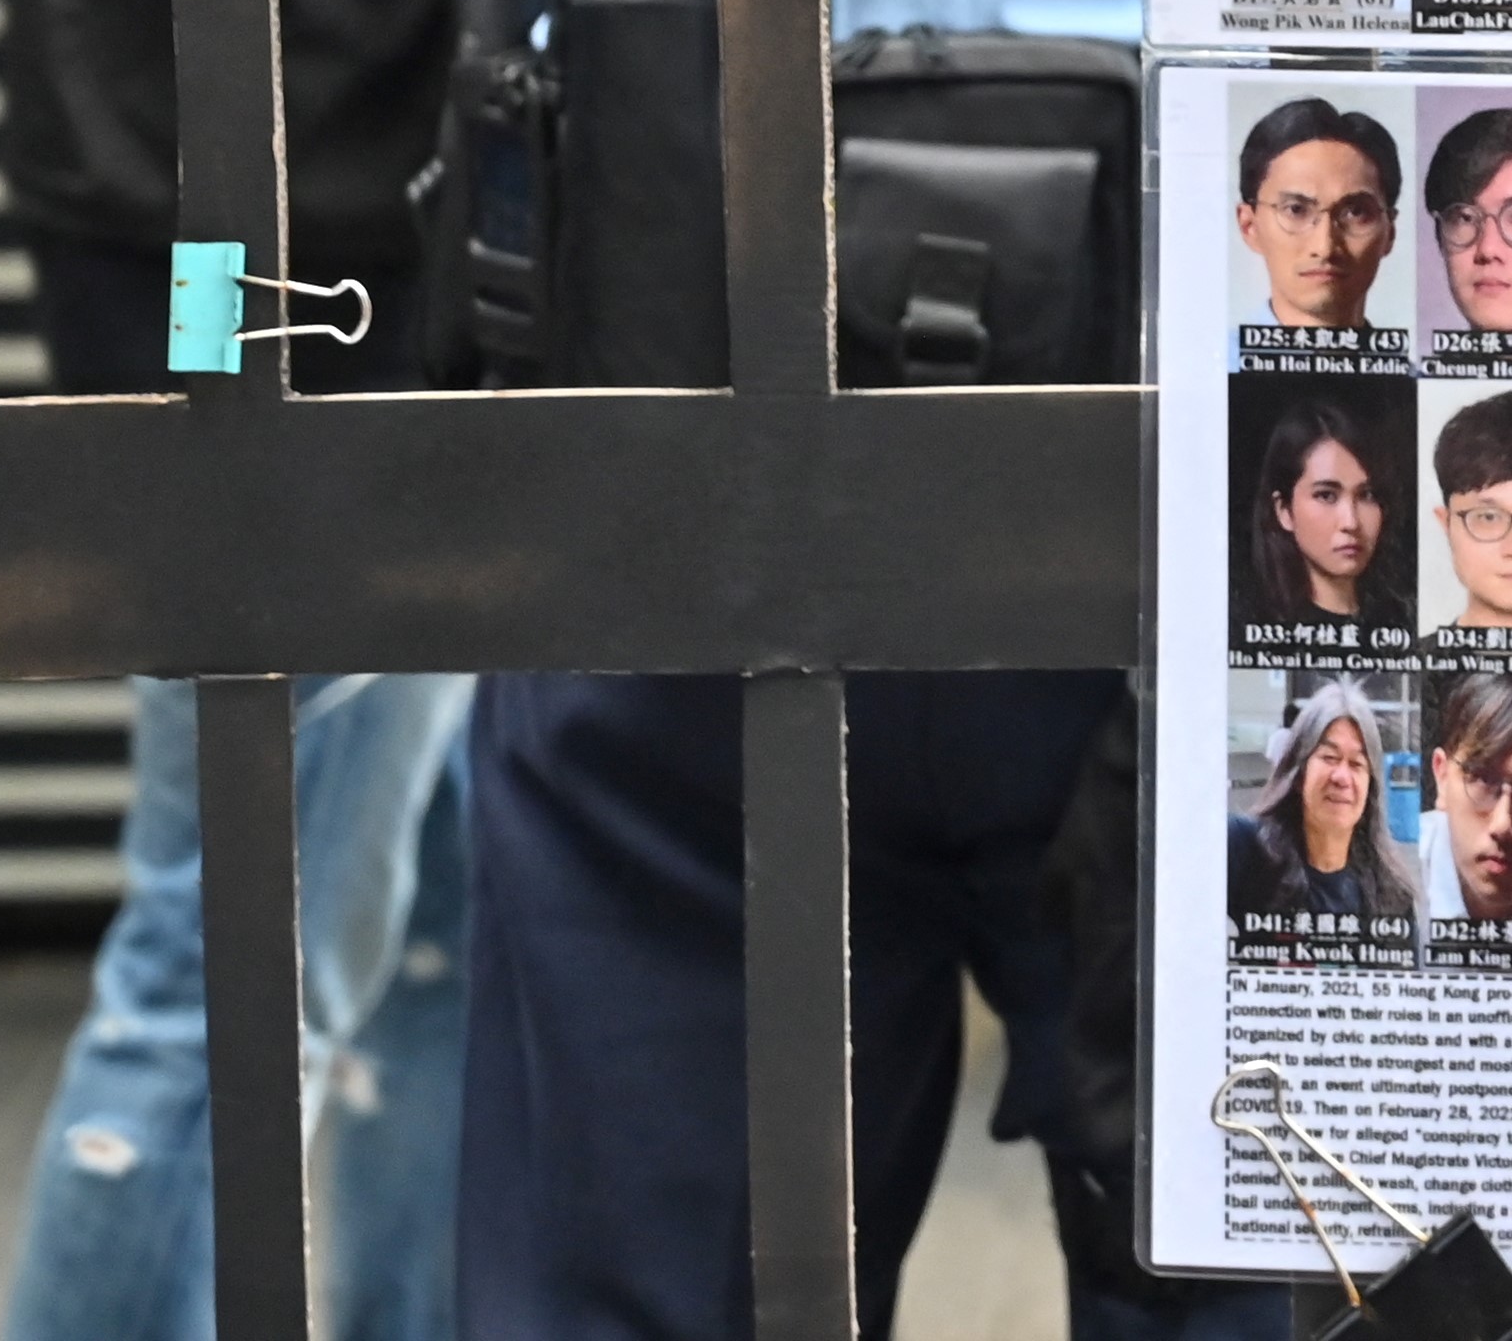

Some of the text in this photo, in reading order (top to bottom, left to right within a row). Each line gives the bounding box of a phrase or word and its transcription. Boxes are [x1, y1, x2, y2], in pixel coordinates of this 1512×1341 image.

[1222, 12, 1410, 31] Wong Pik Wan Helena
[1368, 331, 1409, 354] (43)
[1239, 354, 1409, 376] Chu Hoi Dick Eddie
[1419, 358, 1489, 380] Cheung
[1369, 626, 1412, 651] (30)
[1228, 649, 1422, 675] Ho Kwai Lam Gwyneth
[1368, 917, 1411, 941] (64)
[1228, 940, 1415, 968] Leung Kwok Hung
[1425, 947, 1465, 966] Lam
[1469, 948, 1512, 969] King
[1232, 978, 1248, 993] IN
[1254, 979, 1314, 998] January,
[1320, 981, 1364, 998] 2021,
[1371, 983, 1392, 997] 55
[1398, 983, 1437, 1002] Hong
[1443, 985, 1480, 1003] Kong
[1232, 1004, 1312, 1019] connection
[1317, 1005, 1346, 1019] with
[1350, 1006, 1384, 1021] their
[1388, 1007, 1423, 1021] roles
[1428, 1009, 1441, 1023] in
[1446, 1012, 1463, 1023] an
